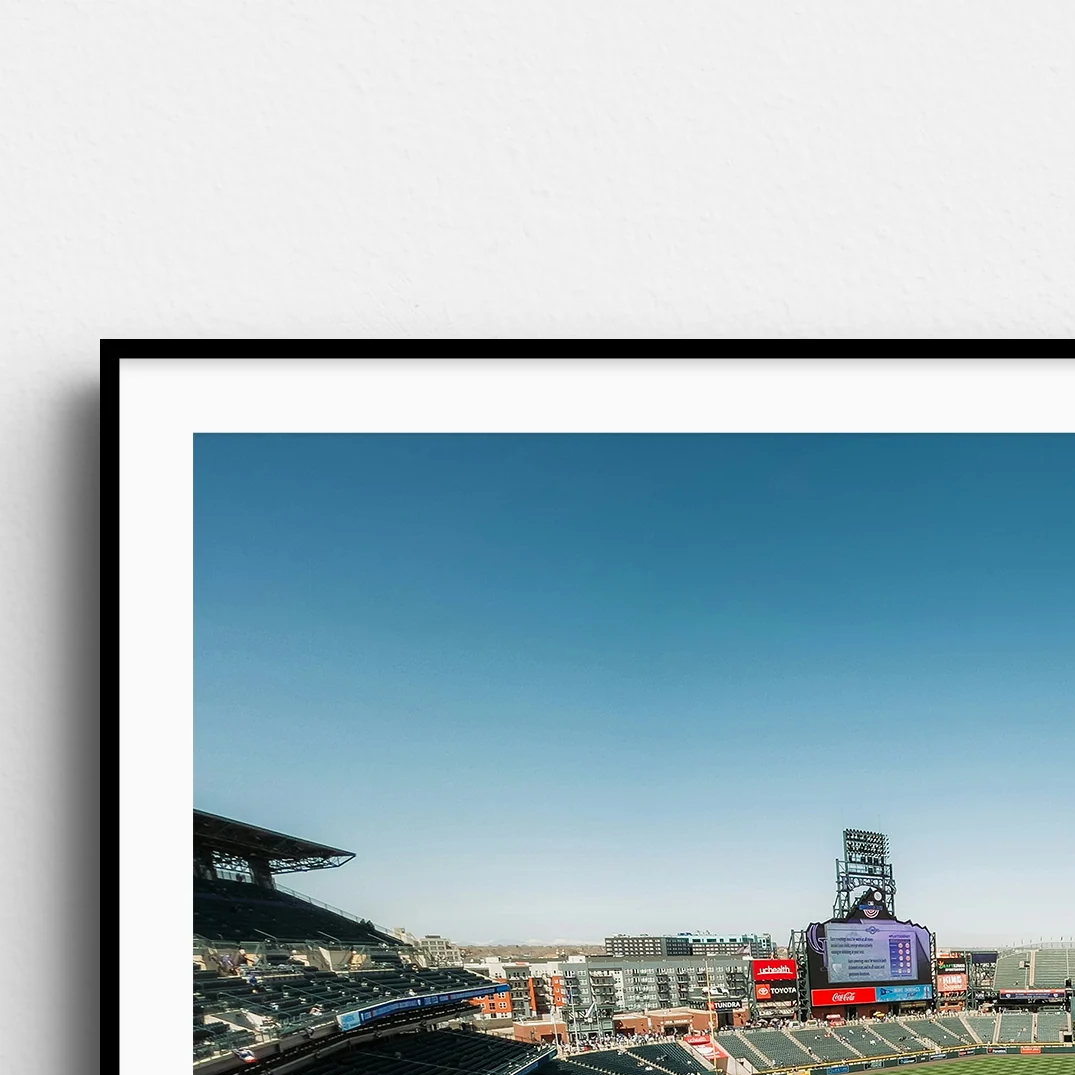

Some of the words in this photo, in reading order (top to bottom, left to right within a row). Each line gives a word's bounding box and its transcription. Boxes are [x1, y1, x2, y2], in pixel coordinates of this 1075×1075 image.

[758, 965, 792, 975] uchealth
[770, 987, 797, 995] TOYOTA
[831, 991, 856, 1003] Coca-Cola
[714, 1001, 741, 1009] TUNDRA
